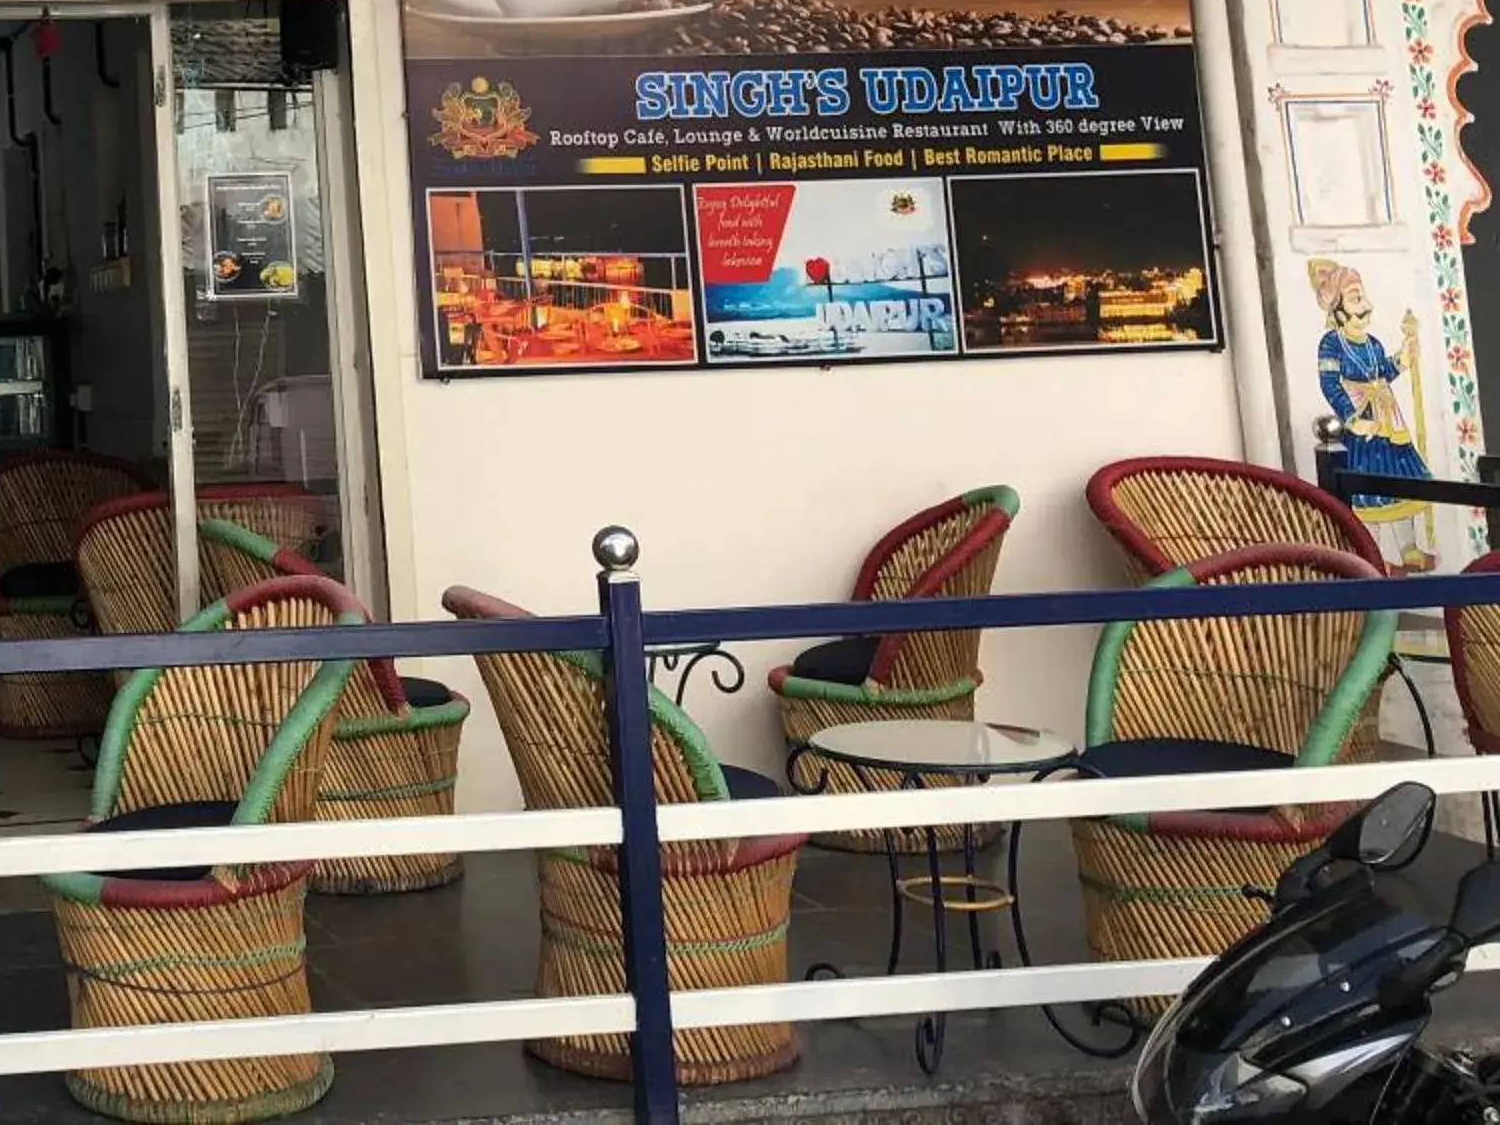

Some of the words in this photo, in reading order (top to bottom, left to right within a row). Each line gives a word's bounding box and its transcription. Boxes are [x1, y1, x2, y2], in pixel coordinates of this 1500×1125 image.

[636, 68, 850, 120] SINGH'S
[861, 62, 1100, 114] UDAIPUR
[550, 128, 618, 150] Rooftop
[673, 126, 742, 146] Lounge
[748, 126, 760, 142] &
[766, 123, 888, 143] Worldcuisine
[892, 122, 989, 139] Restaurant
[998, 119, 1042, 136] With
[1045, 118, 1073, 135] 360
[1078, 117, 1135, 136] degree
[1141, 115, 1184, 131] View
[652, 154, 700, 172] Selfie
[705, 153, 750, 171] Point
[770, 151, 859, 173] Rajasthani
[864, 149, 903, 167] Food
[924, 147, 961, 166] Best
[965, 145, 1043, 164] Romantic
[1048, 143, 1093, 162] Place
